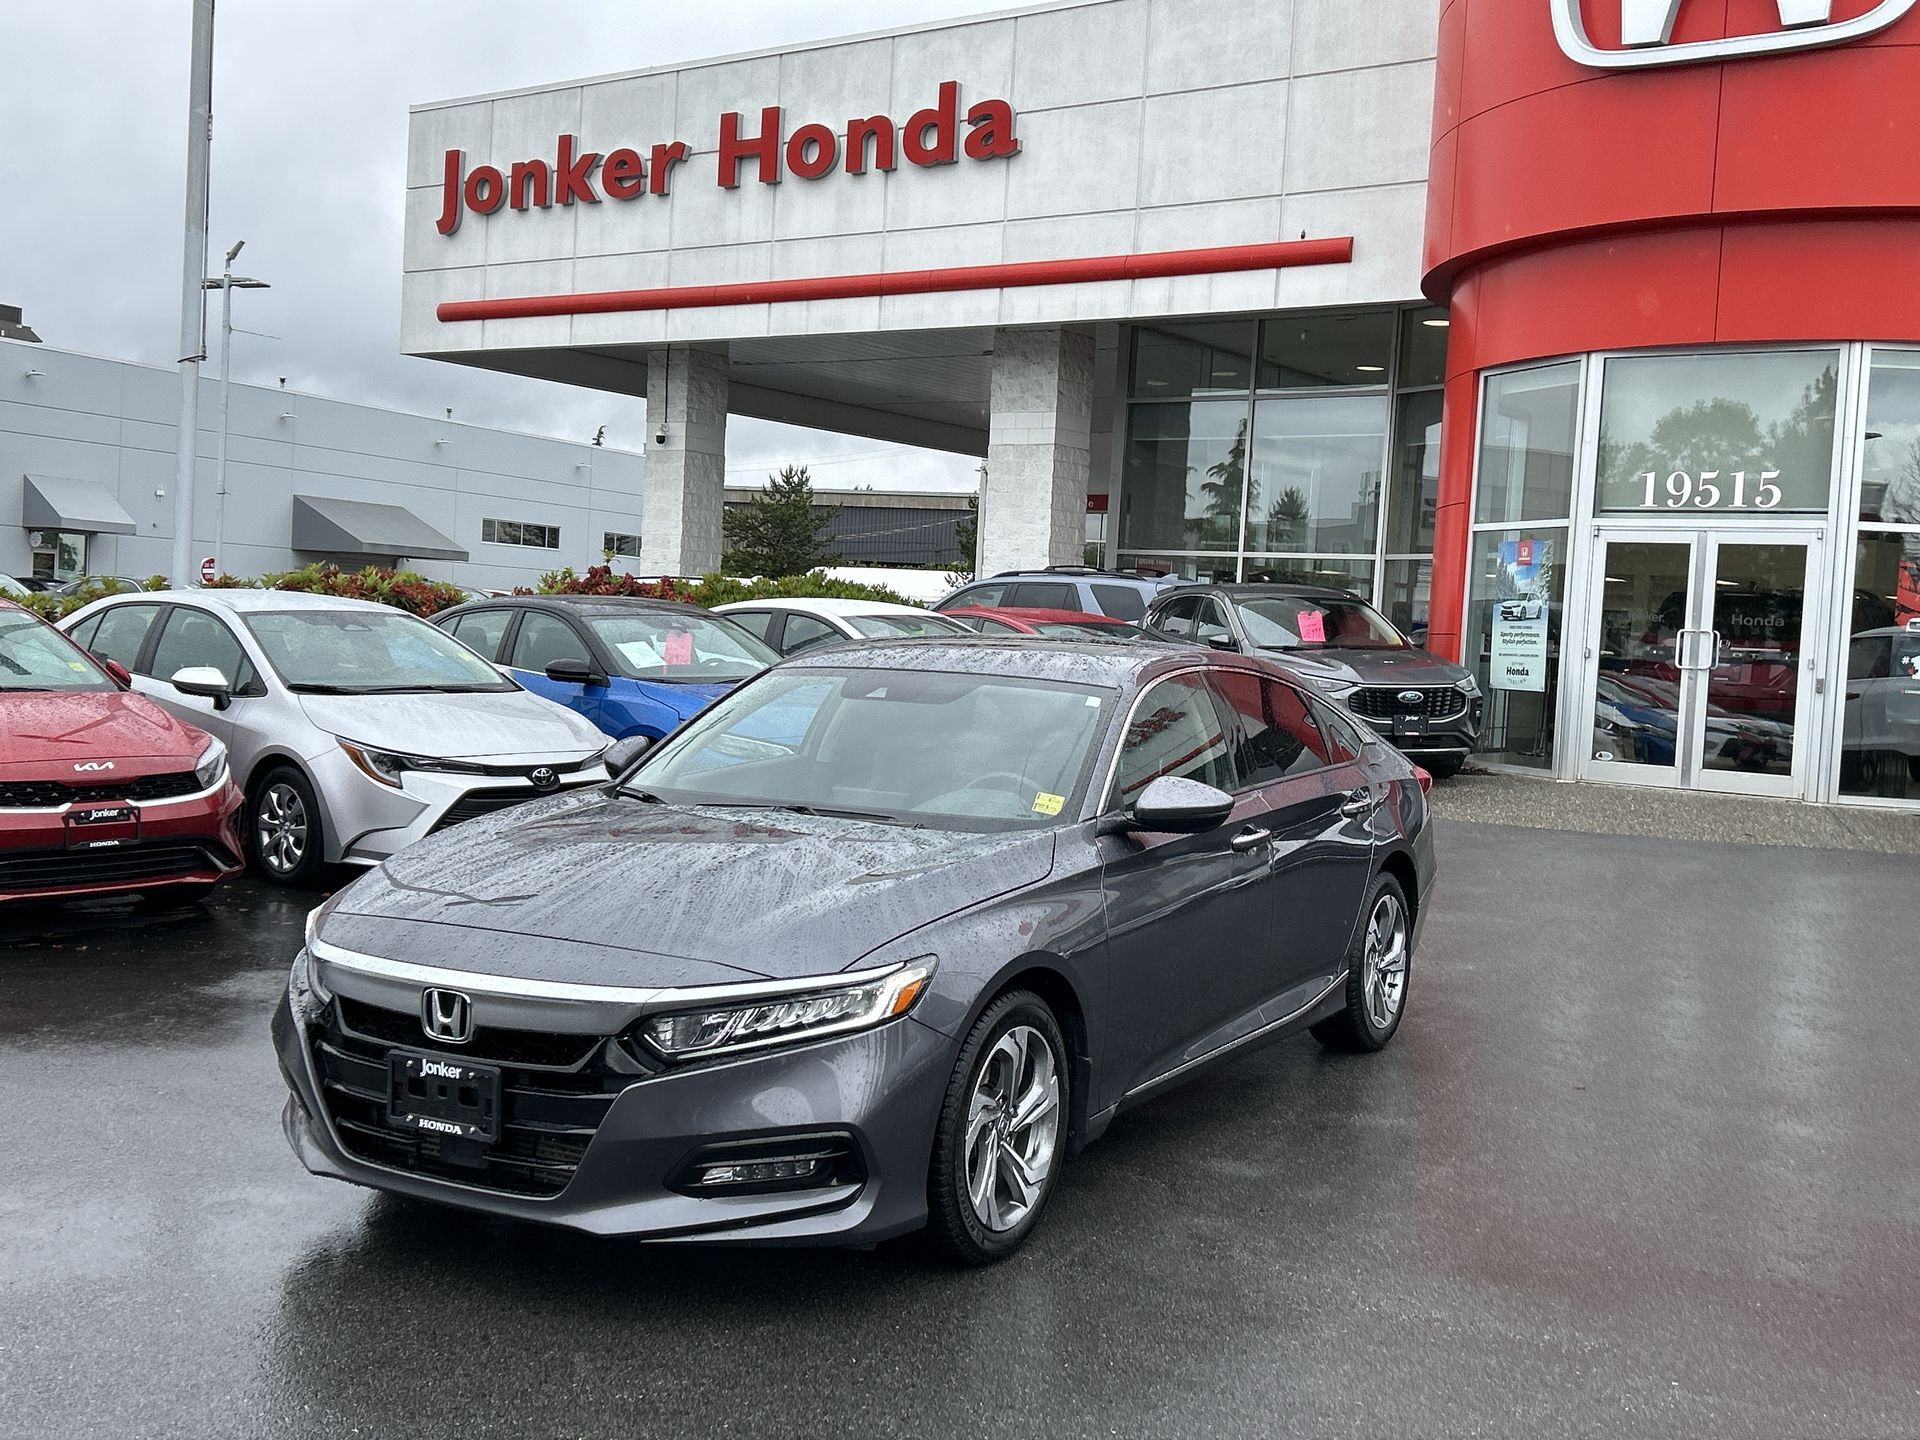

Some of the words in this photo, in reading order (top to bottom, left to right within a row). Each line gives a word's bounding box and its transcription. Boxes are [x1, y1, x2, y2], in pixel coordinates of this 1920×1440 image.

[435, 134, 692, 236] Jonker
[717, 80, 1023, 190] Honda
[1640, 469, 1782, 508] 19515
[1731, 613, 1785, 627] Honda
[1506, 666, 1529, 676] Honda
[90, 809, 119, 820] Jonker
[420, 1058, 462, 1078] Jonker
[418, 1119, 462, 1135] HONDA
